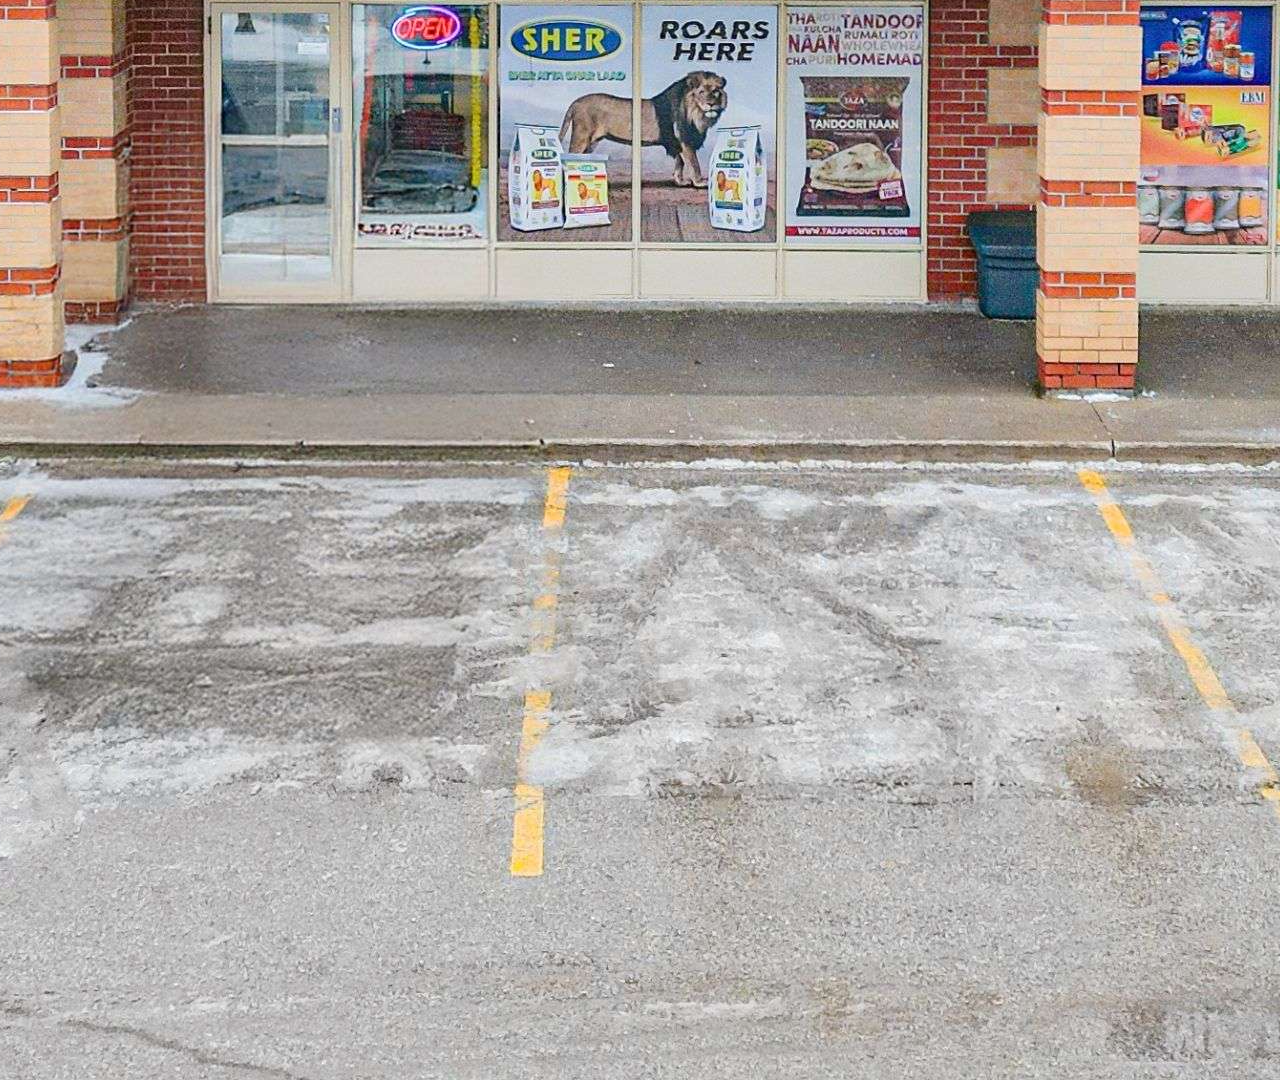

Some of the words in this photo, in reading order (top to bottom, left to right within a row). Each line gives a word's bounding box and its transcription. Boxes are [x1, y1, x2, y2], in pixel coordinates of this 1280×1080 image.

[396, 15, 455, 40] OPEN
[660, 20, 770, 40] ROARS
[803, 25, 842, 34] KULCHA
[844, 30, 888, 40] RUMALI
[522, 27, 607, 55] SHER
[788, 34, 840, 54] NAAN
[672, 42, 755, 61] HERE
[1241, 91, 1265, 104] EBM
[810, 119, 867, 129] TANDOORI
[869, 119, 899, 129] NAAN
